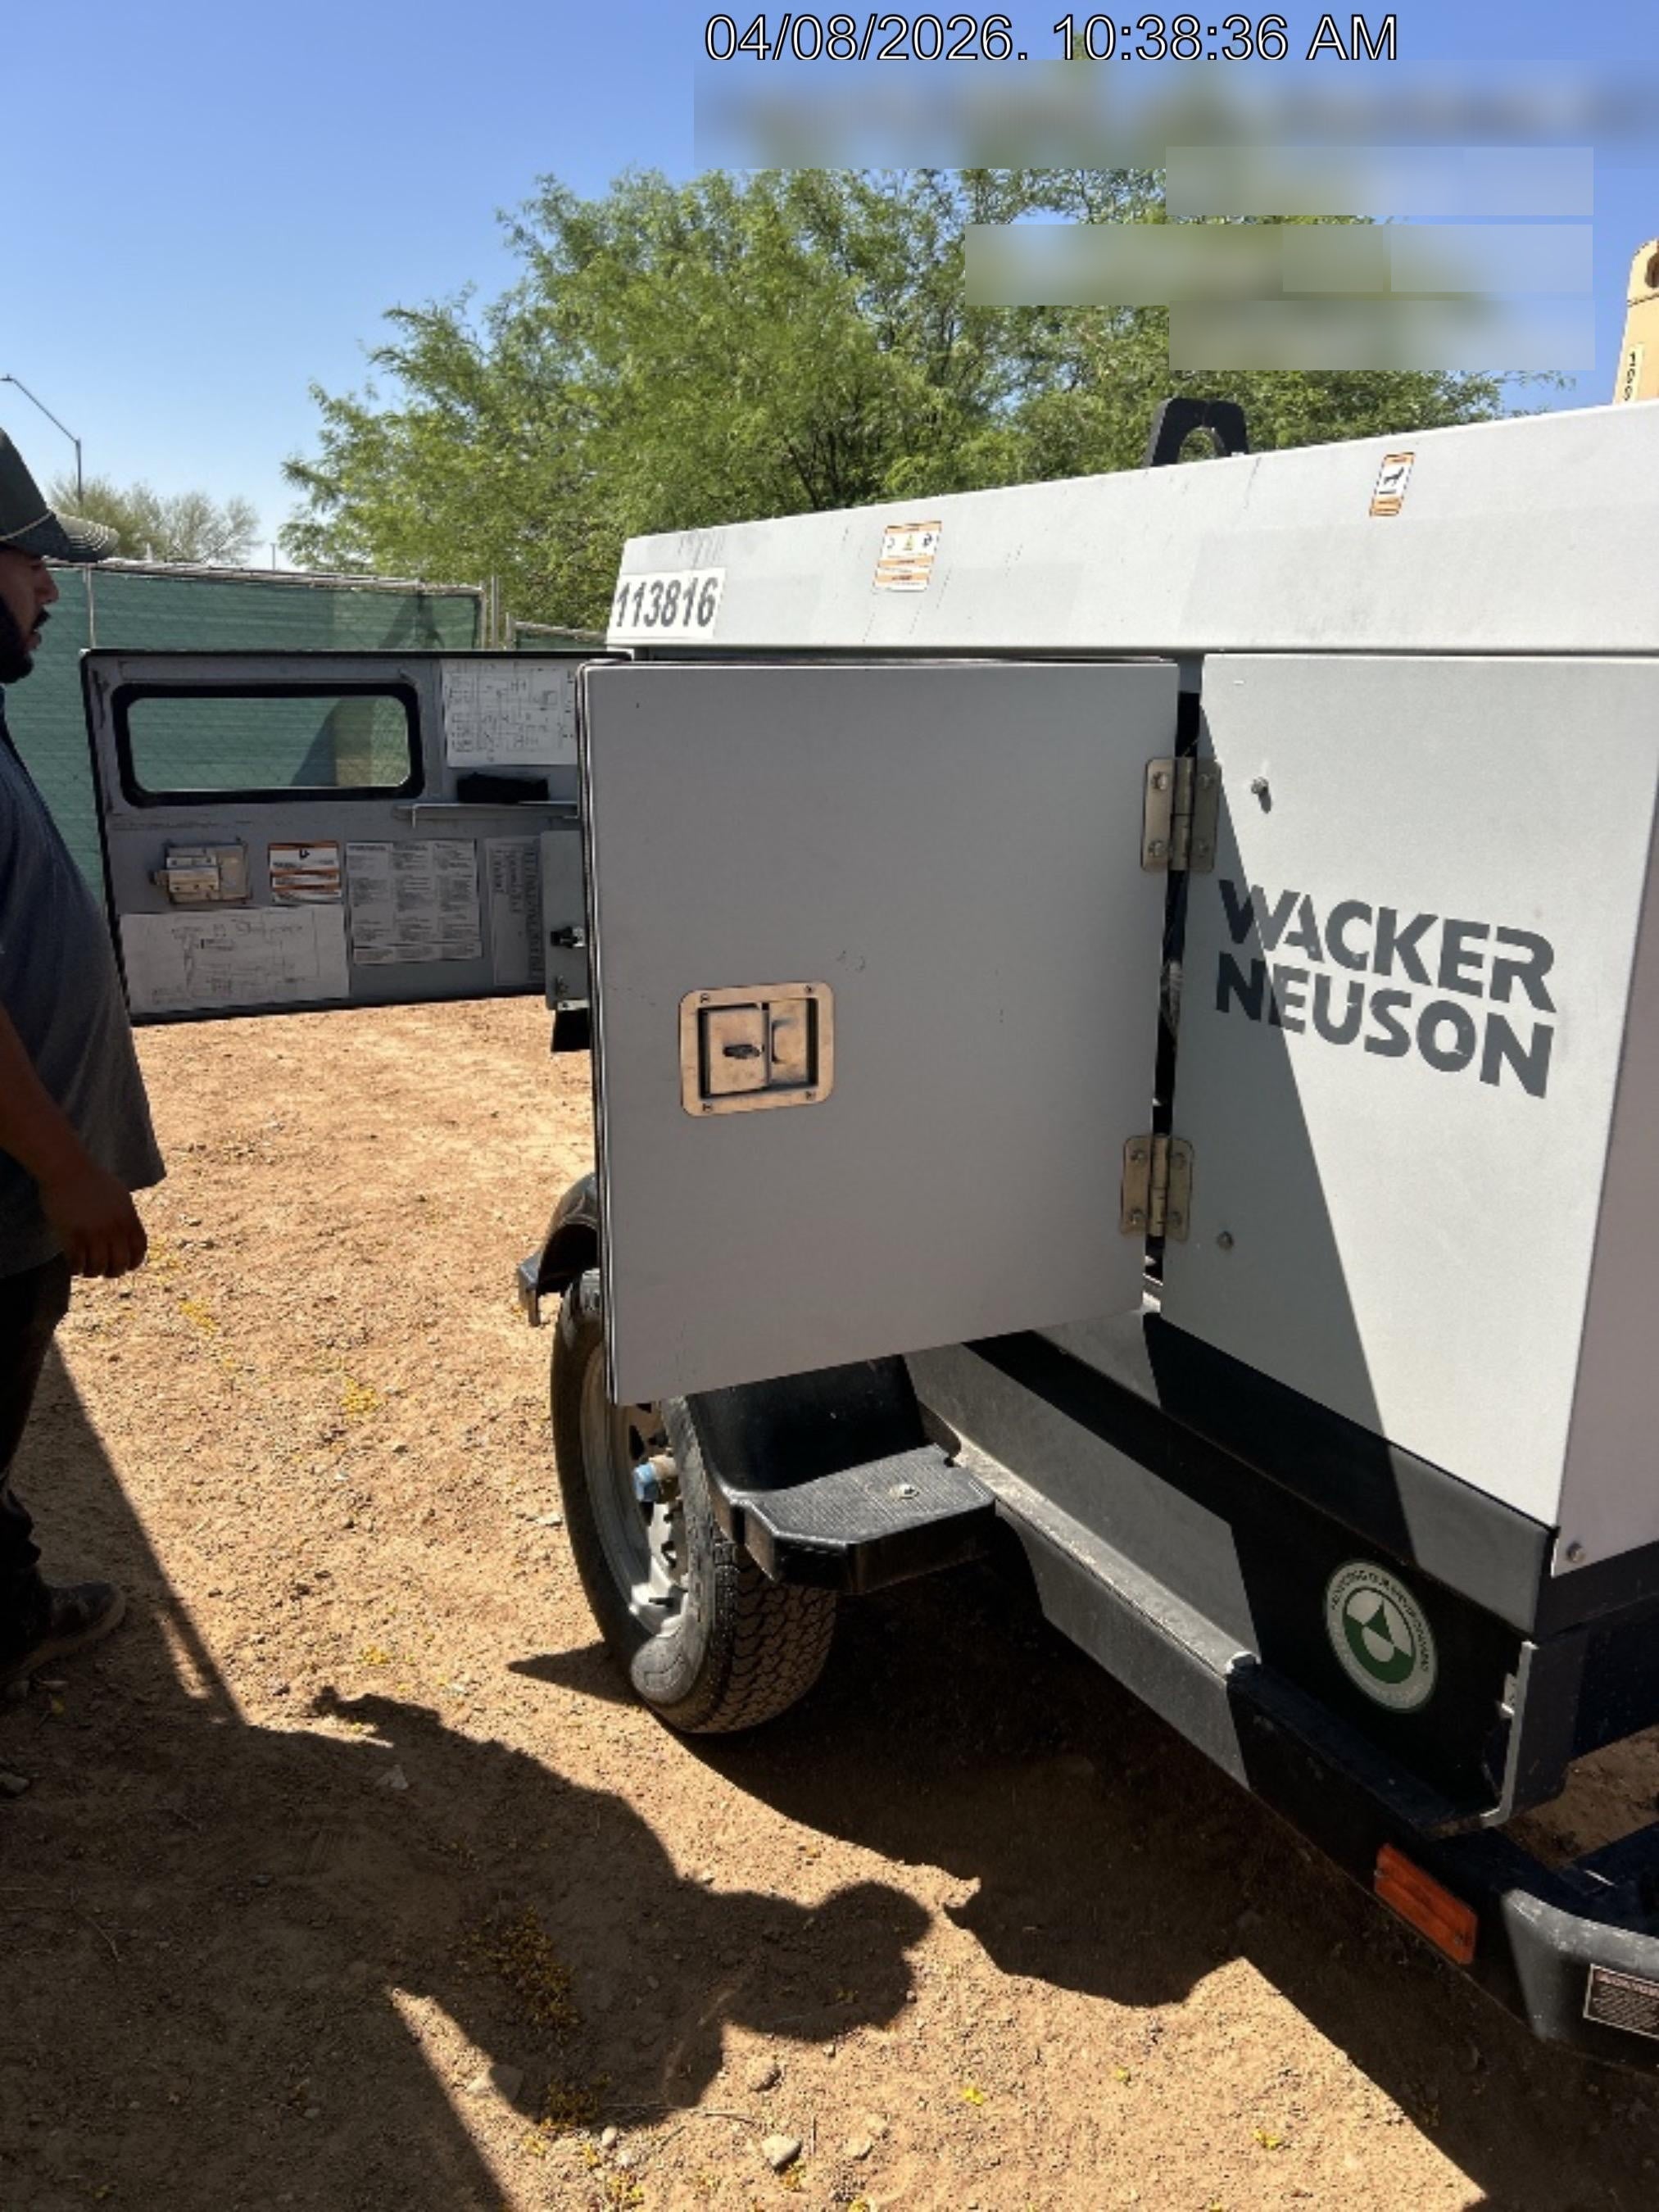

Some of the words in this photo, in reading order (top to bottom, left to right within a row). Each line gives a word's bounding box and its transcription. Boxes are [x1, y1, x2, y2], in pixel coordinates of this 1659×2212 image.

[616, 577, 718, 628] 113816
[1218, 878, 1557, 1013] WACKER
[1216, 952, 1555, 1099] NEUSON
